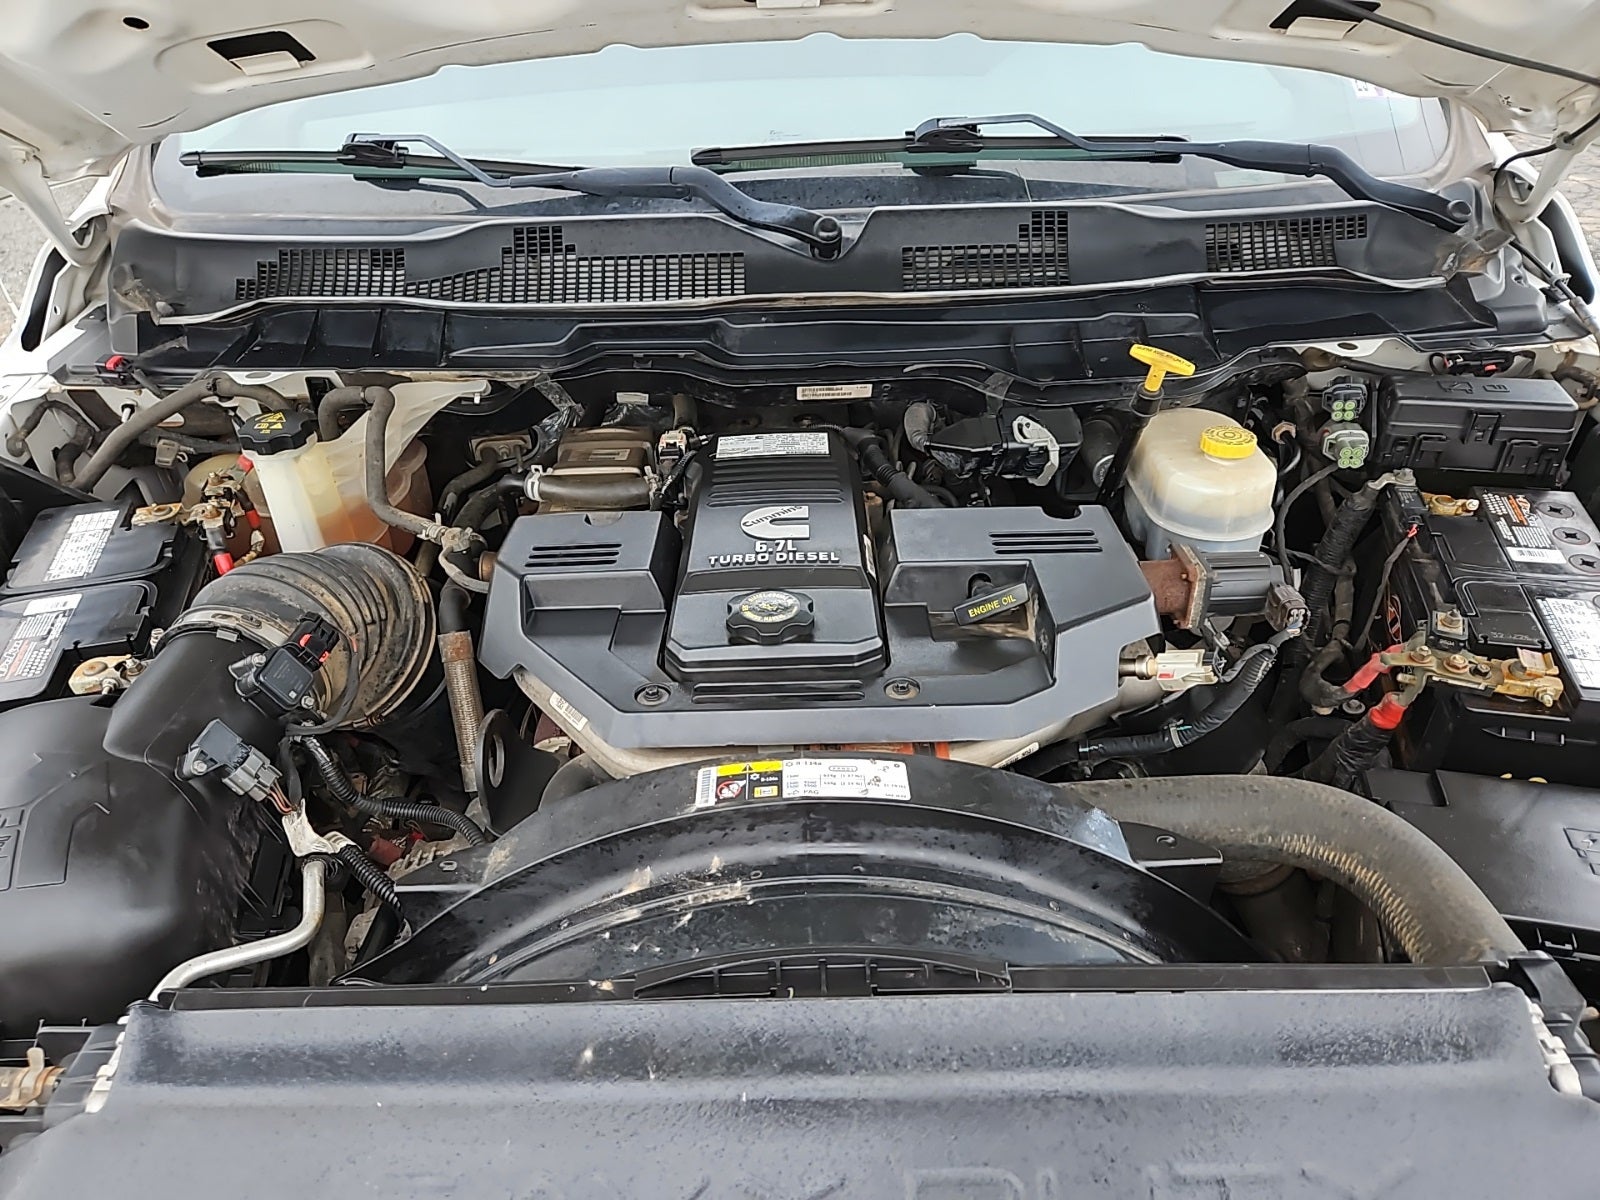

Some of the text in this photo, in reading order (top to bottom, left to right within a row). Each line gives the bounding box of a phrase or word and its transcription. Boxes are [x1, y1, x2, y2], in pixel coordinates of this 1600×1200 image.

[755, 539, 798, 553] 6.7L
[708, 551, 840, 566] TURBO DIESEL
[967, 594, 1017, 618] ENGINE OIL
